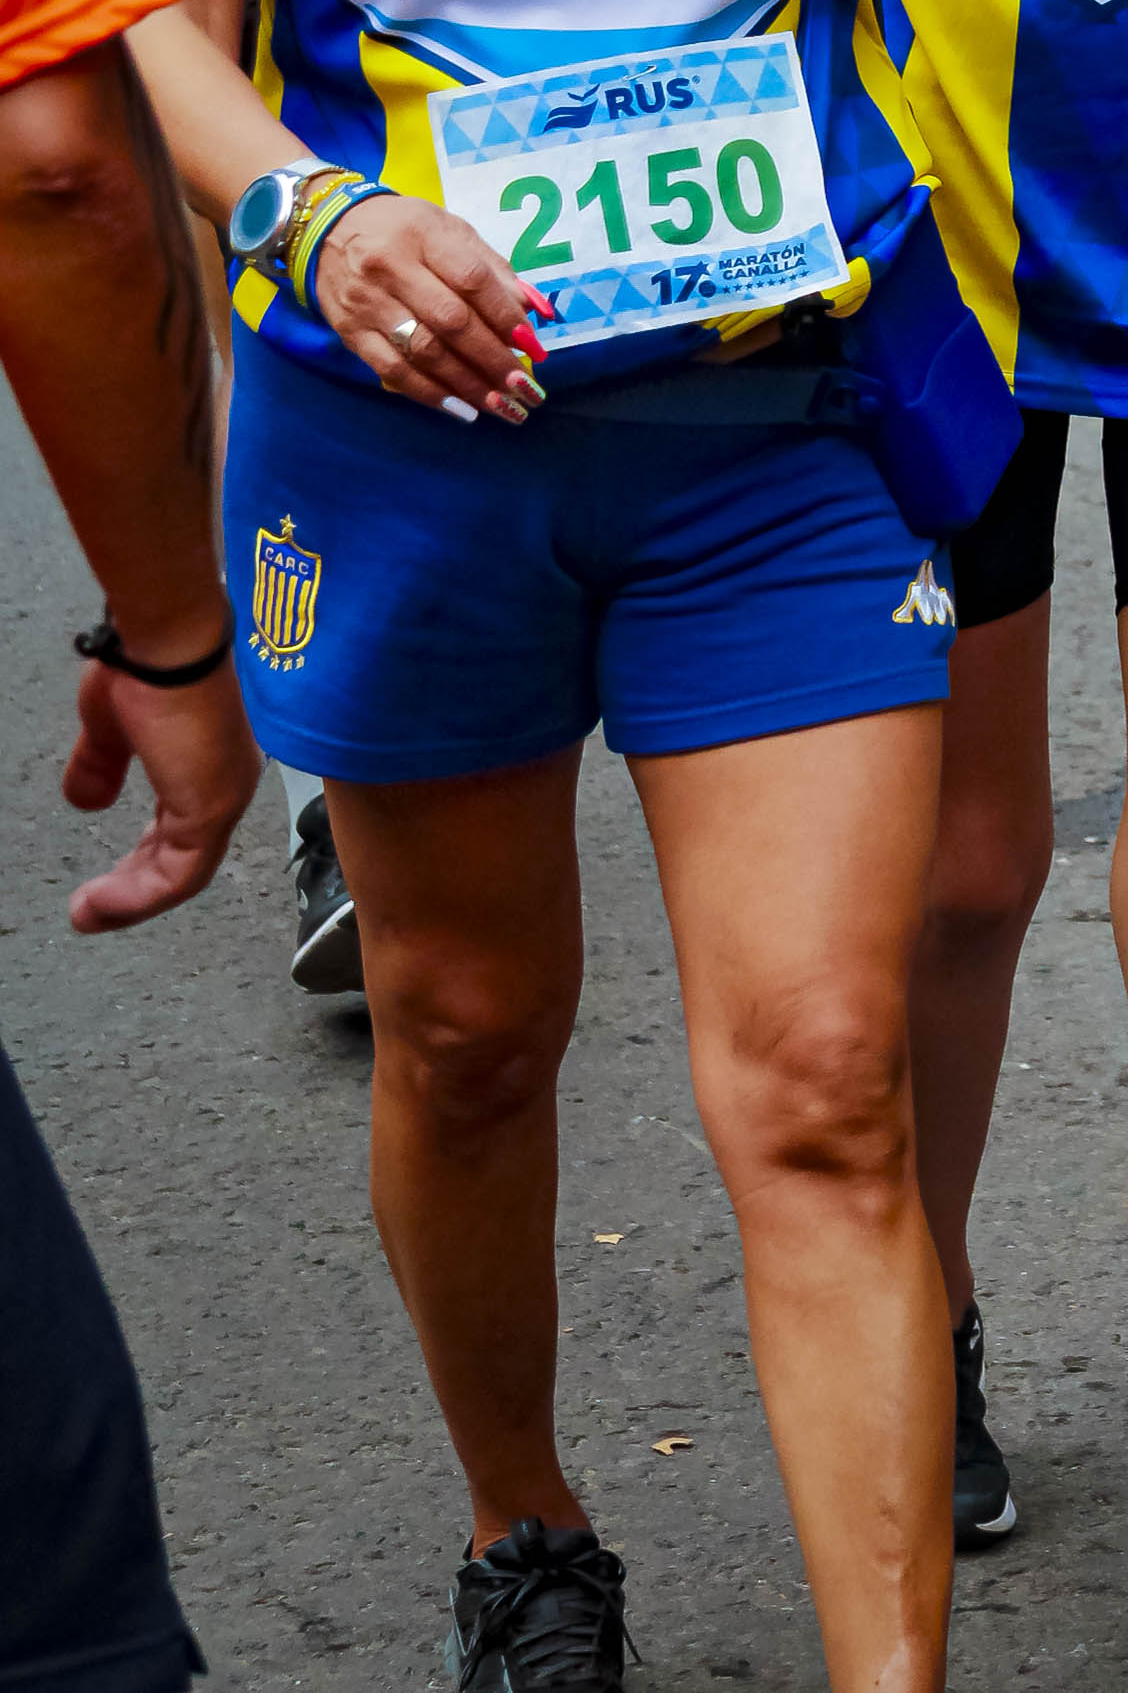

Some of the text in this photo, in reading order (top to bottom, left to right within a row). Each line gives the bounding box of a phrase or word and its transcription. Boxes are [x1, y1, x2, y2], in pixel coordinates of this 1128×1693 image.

[605, 78, 694, 119] RUS
[499, 139, 783, 273] 2150
[718, 243, 805, 269] MARATÓN
[723, 256, 807, 280] CANALLA
[651, 261, 711, 306] 17
[265, 546, 310, 576] CARC
